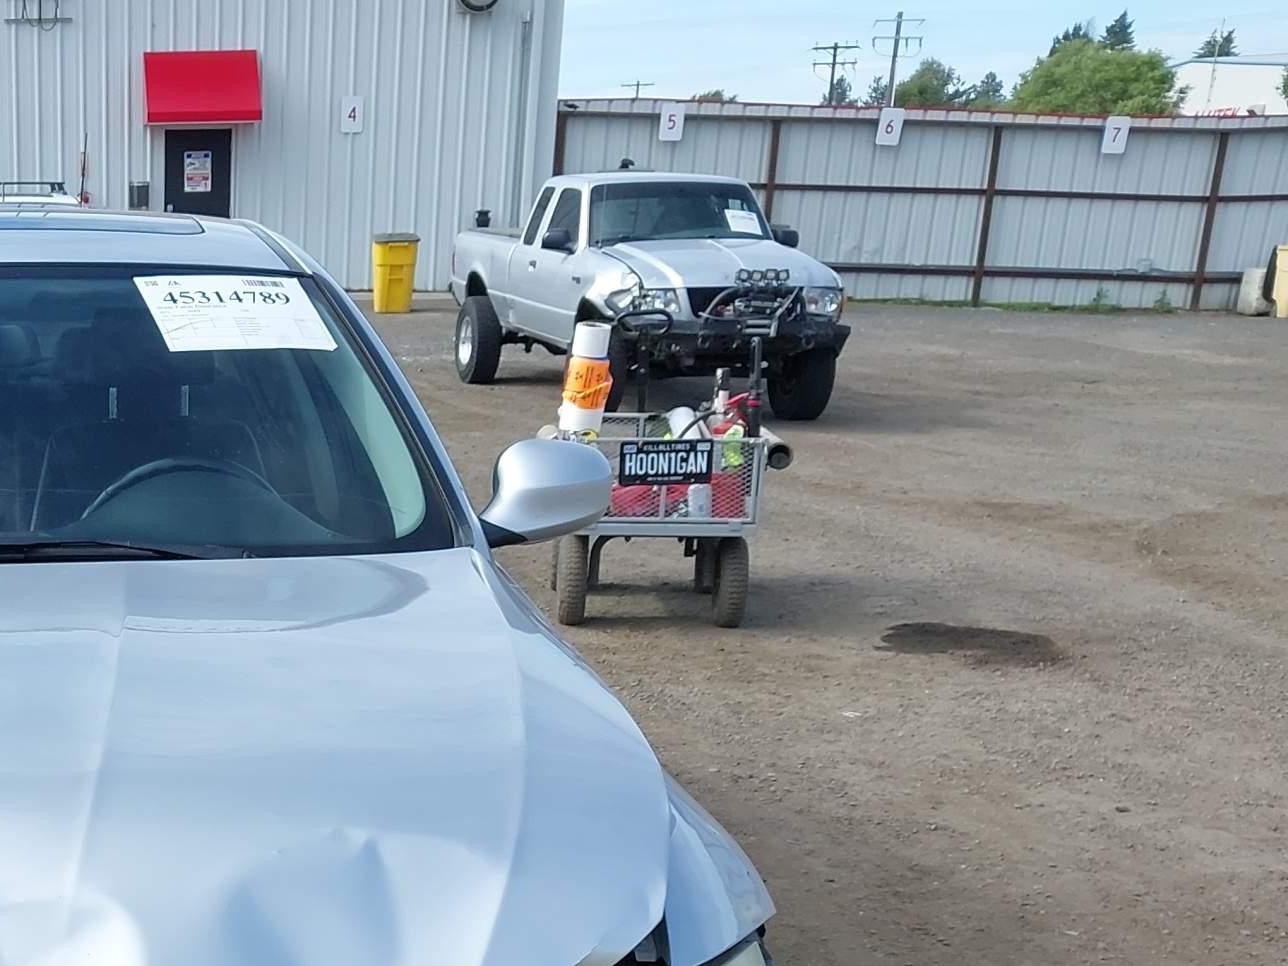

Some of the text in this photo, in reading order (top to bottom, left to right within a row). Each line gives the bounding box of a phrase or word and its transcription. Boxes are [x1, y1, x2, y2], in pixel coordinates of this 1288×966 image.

[347, 107, 358, 122] 4
[667, 114, 677, 130] 5
[884, 119, 895, 136] 6
[1110, 127, 1122, 143] 7
[163, 289, 290, 305] 45314789
